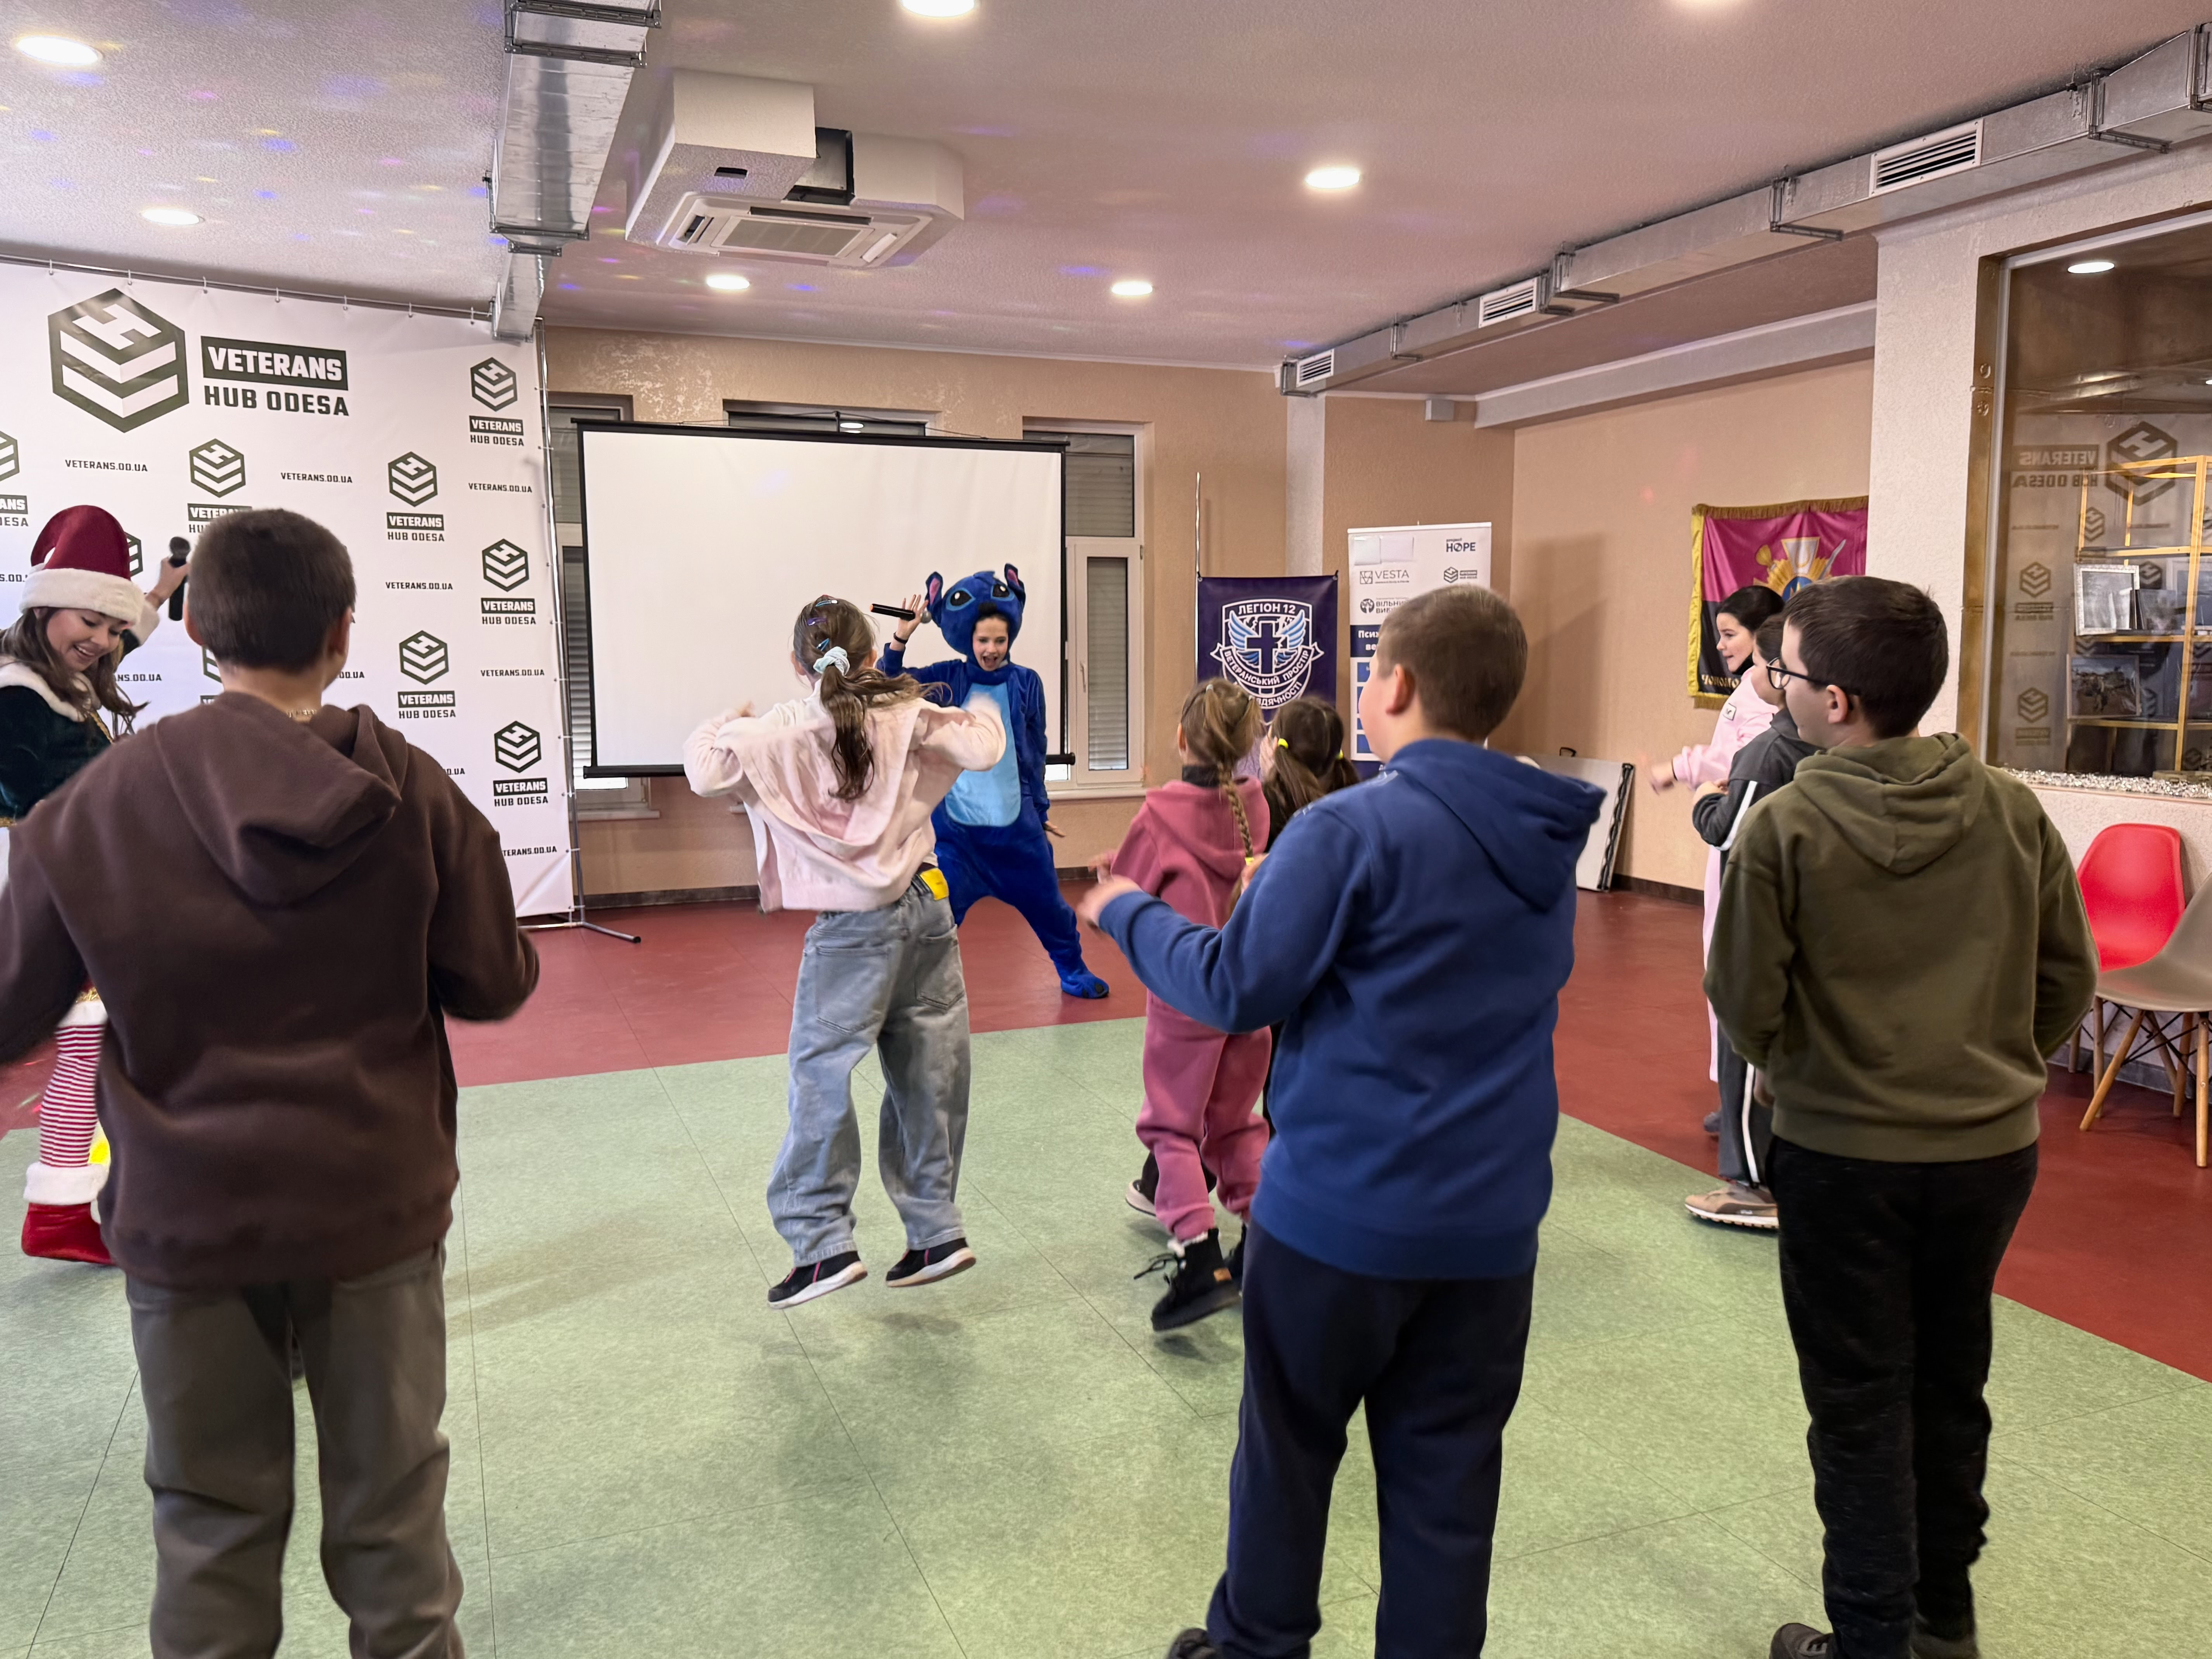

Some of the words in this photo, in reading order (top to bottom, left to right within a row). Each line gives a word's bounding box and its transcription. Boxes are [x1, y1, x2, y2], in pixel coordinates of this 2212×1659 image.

[208, 346, 342, 381] VETERANS
[204, 385, 257, 409] HUB
[266, 391, 349, 416] ODESA
[471, 419, 522, 433] VETERANS
[470, 434, 490, 444] HUB
[493, 436, 524, 447] ODESA
[65, 459, 148, 472] VETERANS.OD.UA
[280, 472, 353, 483] VETERANS.OD.UA
[468, 482, 532, 493] VETERANS.OD.UA
[388, 515, 442, 527] VETERANS
[189, 524, 209, 533] HU
[387, 531, 408, 540] HUB
[412, 532, 445, 542] ODESA
[1446, 542, 1476, 552] HOPE
[0, 574, 28, 582] S.OD.
[1375, 569, 1410, 579] VESTA
[385, 582, 453, 590] VETERANS.OD.UA
[483, 601, 534, 611] VETERANS
[1238, 603, 1281, 615] ЛЕГІОН
[1283, 604, 1296, 614] 12
[482, 616, 501, 625] HUB
[505, 617, 536, 625] ODESA
[480, 669, 545, 677] VETERANS.OD.UA
[1224, 650, 1280, 685] ВЕТЕРАНСЬКИЙ
[1283, 650, 1309, 681] ПРОСТІР
[116, 673, 162, 682] NS.OD.UA
[400, 694, 453, 705] VETERANS
[399, 710, 419, 719] HUB
[423, 709, 456, 718] ODESA
[495, 781, 546, 793] VETERANS
[494, 798, 514, 807] HUB
[517, 796, 548, 805] ODESA
